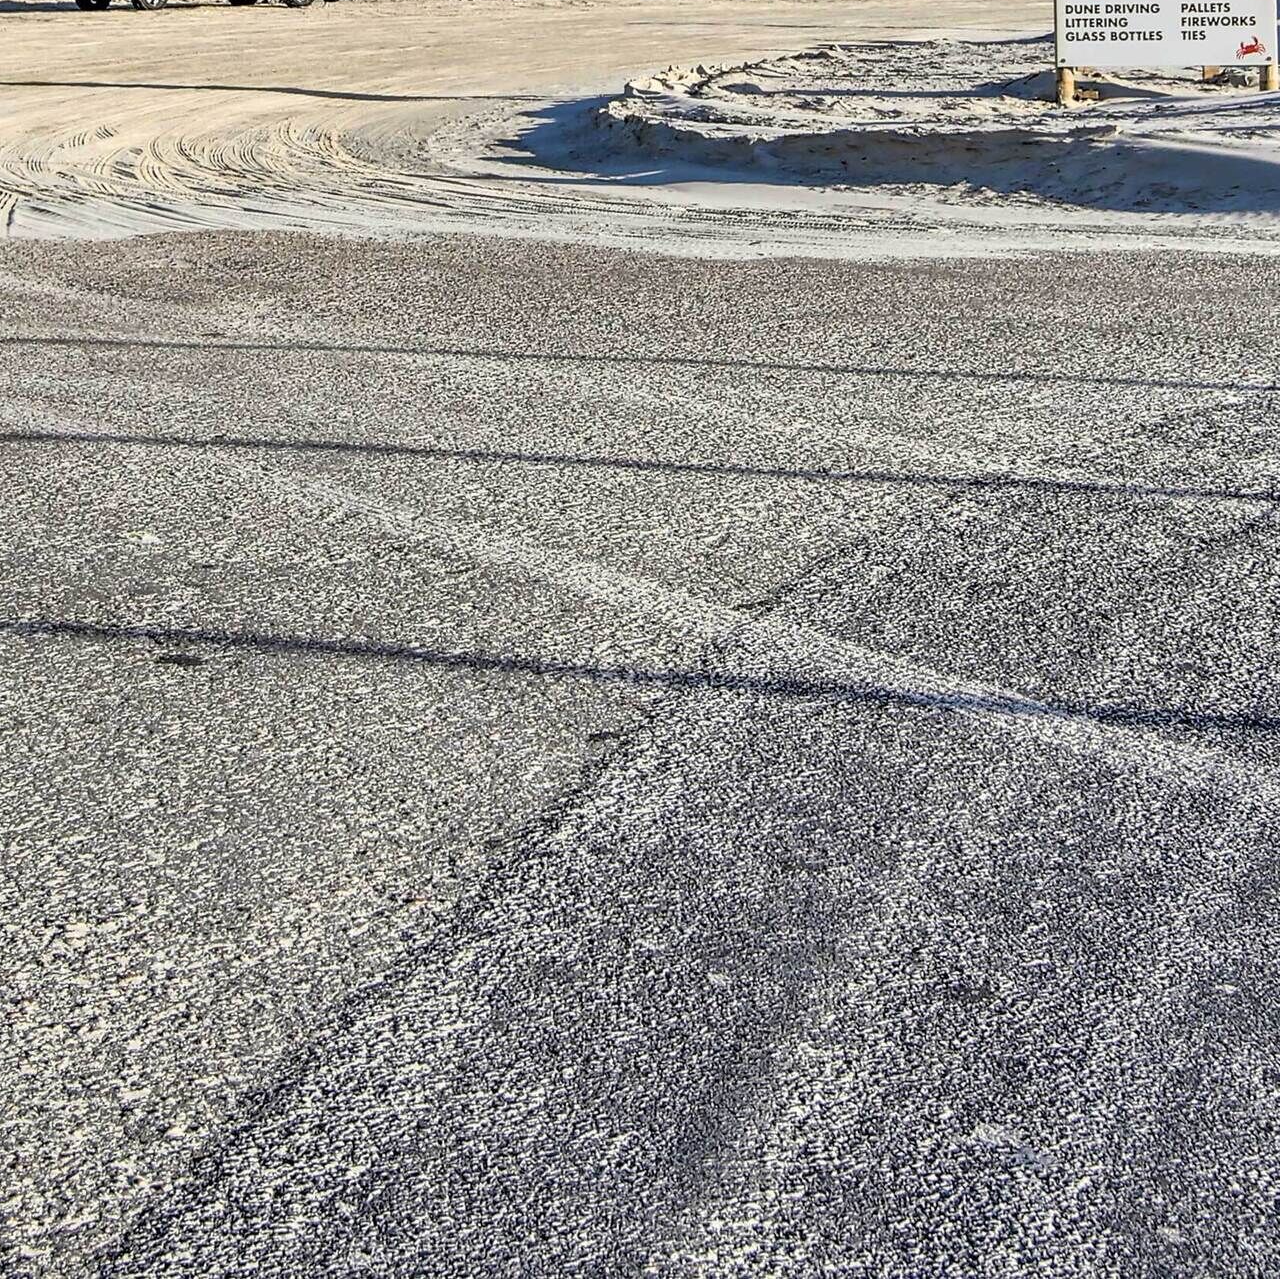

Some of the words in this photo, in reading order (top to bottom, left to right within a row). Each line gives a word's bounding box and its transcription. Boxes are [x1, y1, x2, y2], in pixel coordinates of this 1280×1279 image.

[1065, 4, 1100, 14] DUNE
[1105, 3, 1160, 14] DRIVING
[1181, 3, 1231, 13] PALLETS
[1065, 18, 1128, 28] LITTERING
[1181, 16, 1256, 26] FIREWORKS
[1065, 32, 1106, 42] GLASS
[1110, 31, 1163, 41] BOTTLES
[1181, 30, 1207, 40] TIES
